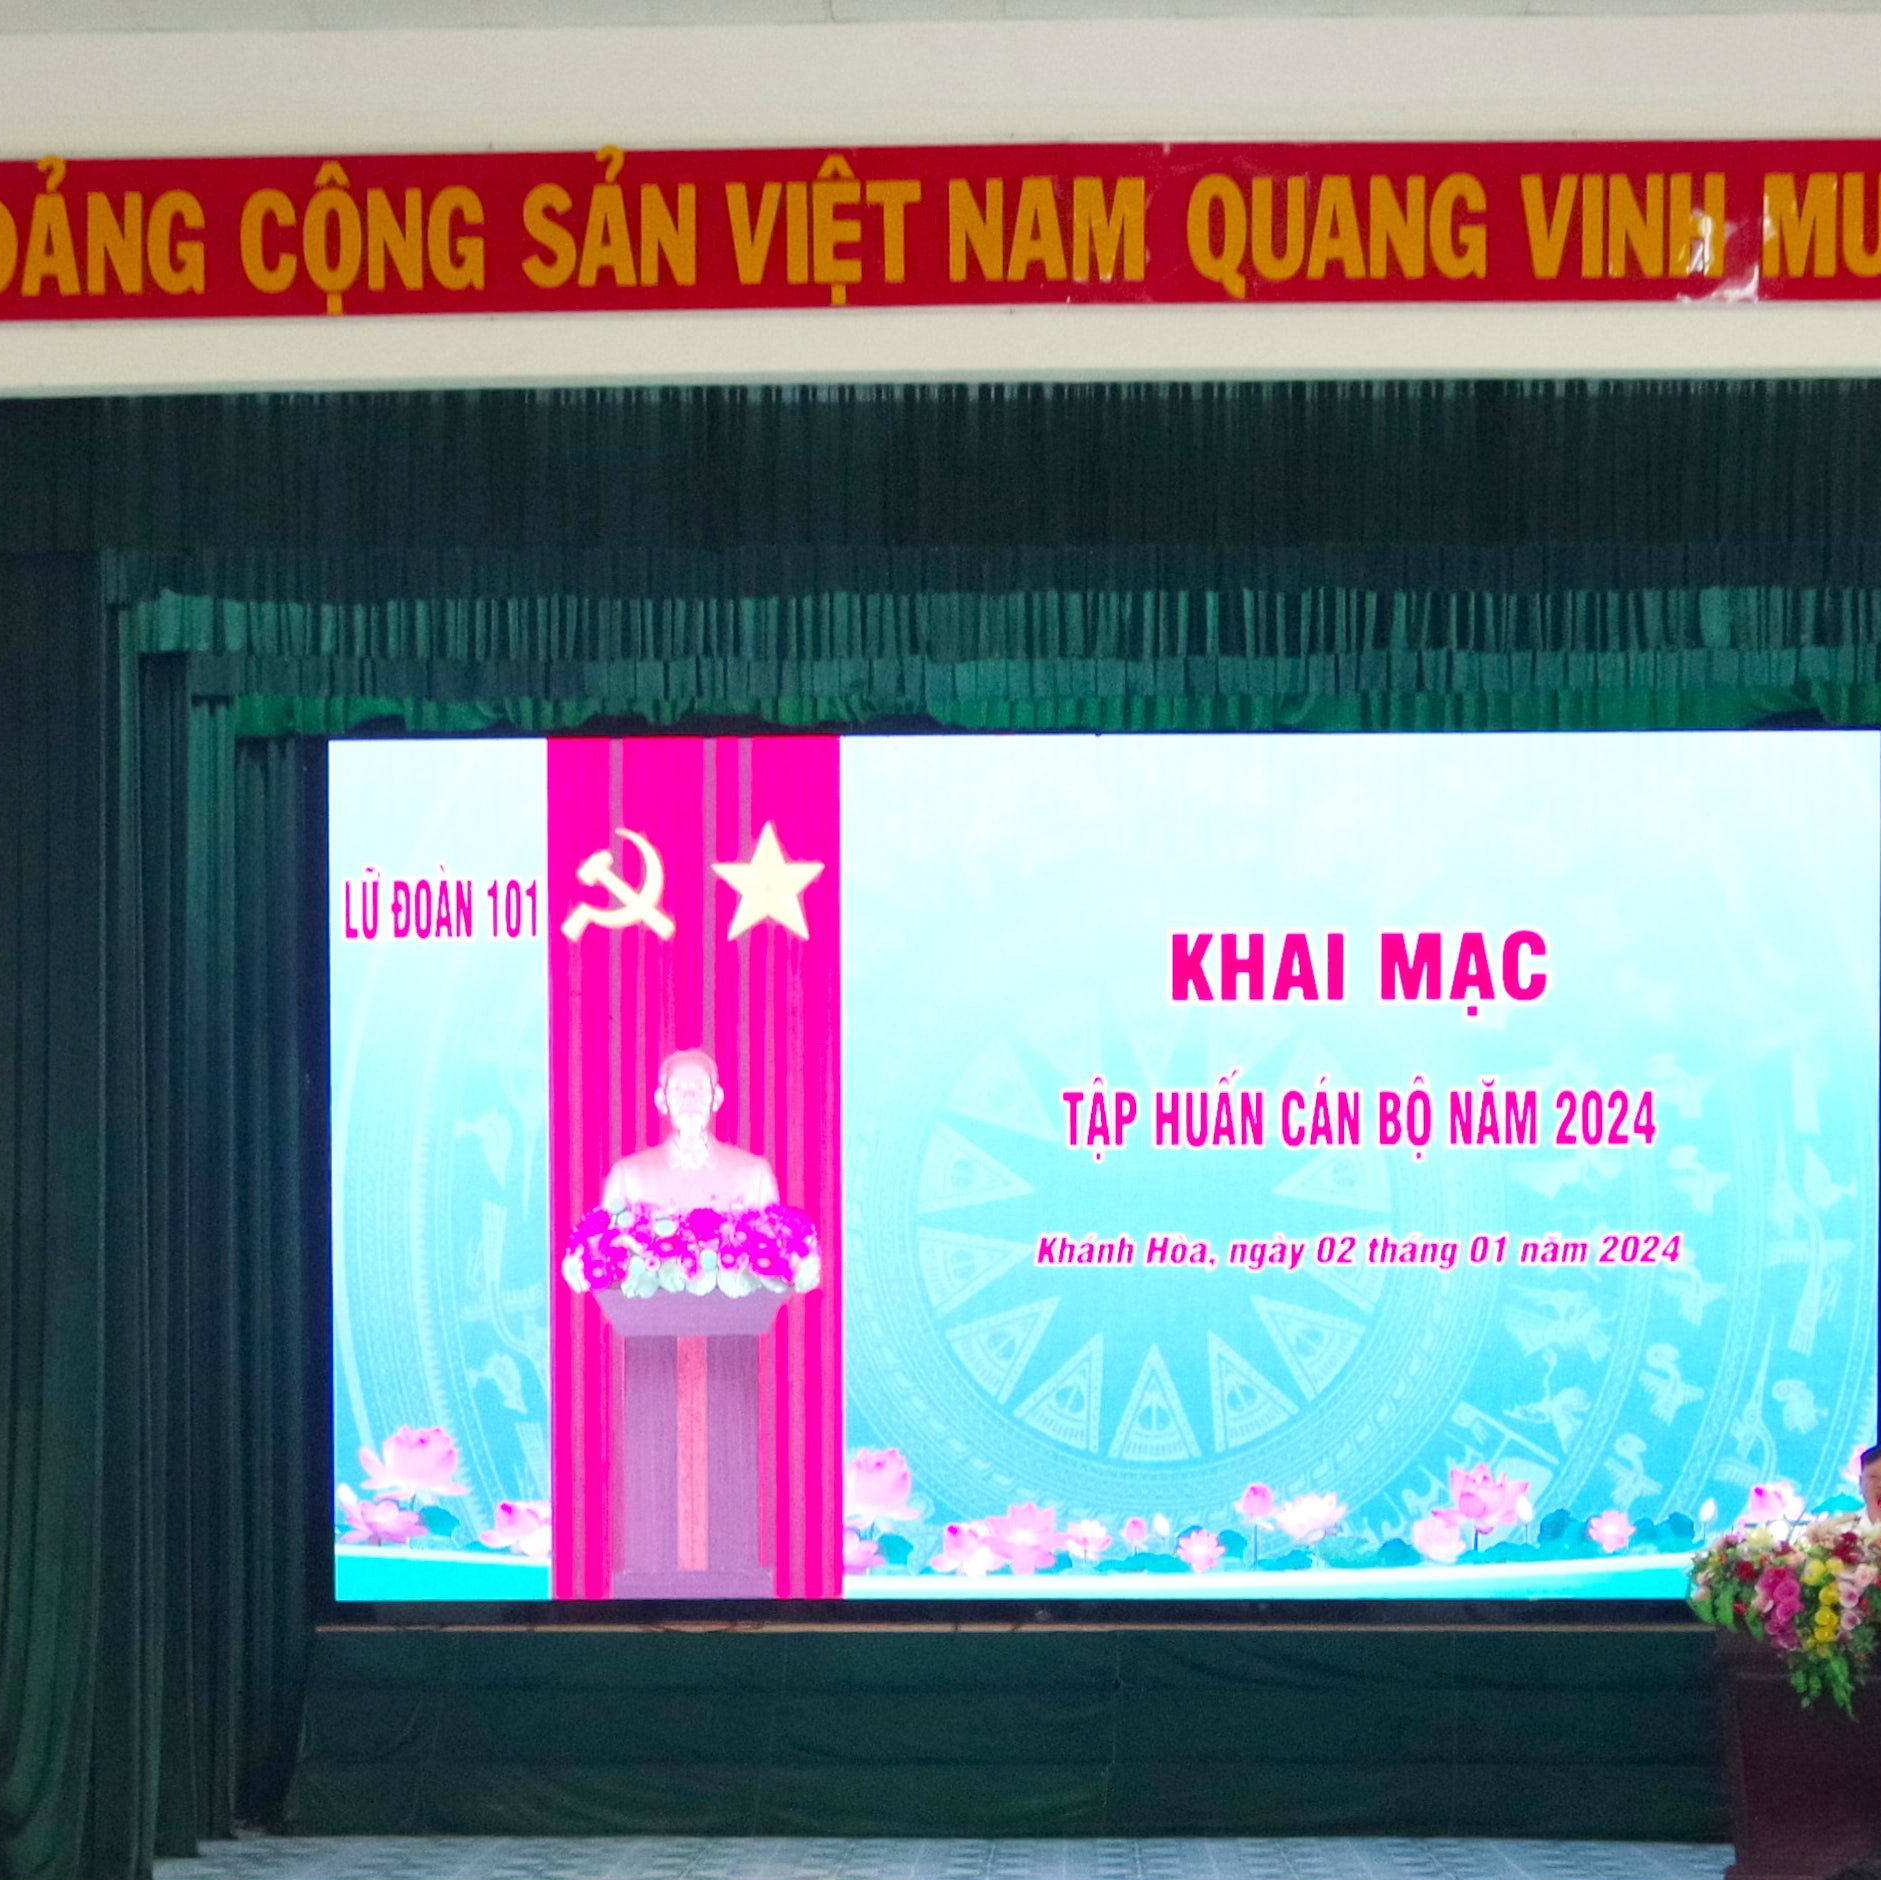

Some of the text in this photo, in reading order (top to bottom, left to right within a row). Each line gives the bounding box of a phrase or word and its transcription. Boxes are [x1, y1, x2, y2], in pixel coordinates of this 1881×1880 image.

[240, 162, 485, 316] CỘNG
[523, 145, 696, 287] SẢN
[726, 155, 922, 306] VIỆT
[949, 177, 1146, 282] NAM
[1187, 174, 1487, 298] QUANG
[1520, 173, 1725, 278] VINH
[345, 864, 537, 939] LỮ ĐOÀN 101
[1171, 929, 1549, 1017] KHAI MẠC
[1062, 1069, 1656, 1160] TẬP HUẤN CÁN BỘ NĂM 2024
[1036, 1234, 1683, 1271] Khánh Hòa, ngày 02 tháng 01 năm 2024
